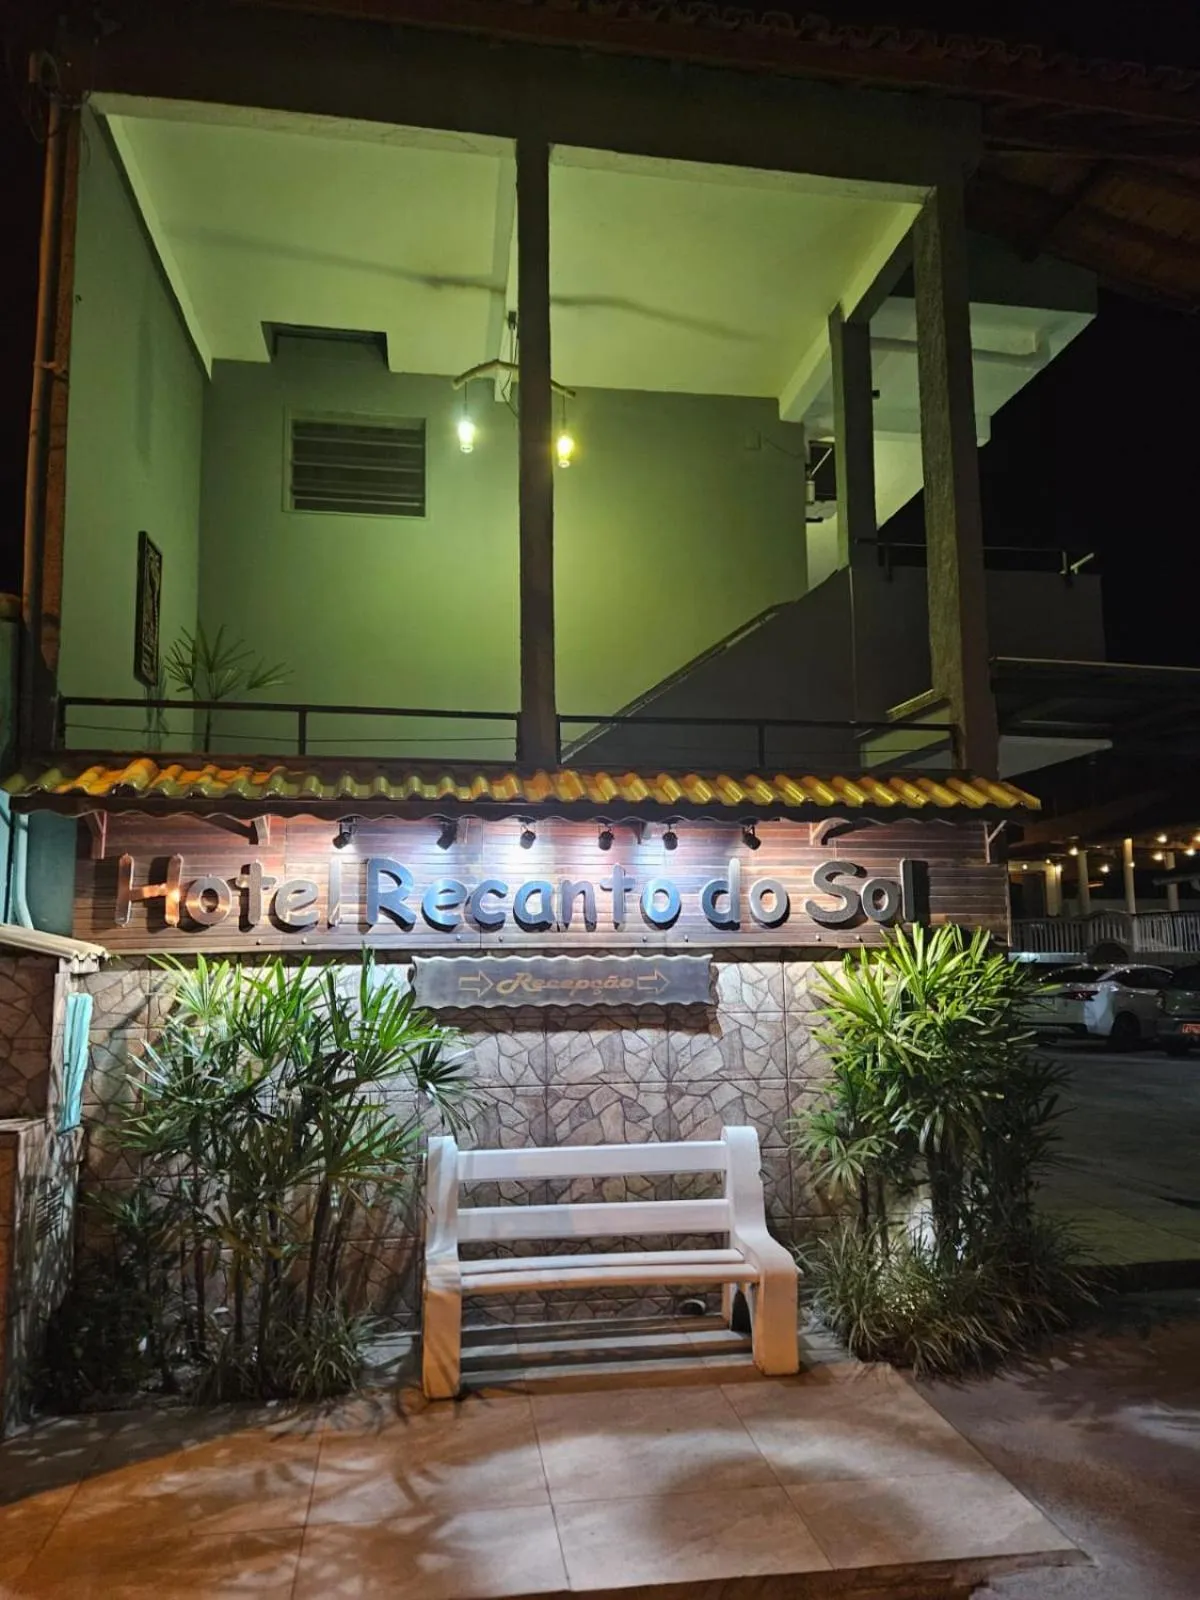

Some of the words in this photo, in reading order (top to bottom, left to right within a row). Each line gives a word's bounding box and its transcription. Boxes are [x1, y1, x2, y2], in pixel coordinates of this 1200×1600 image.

[114, 853, 341, 928] Hotel
[366, 857, 682, 931] Recanto
[700, 857, 788, 930] do
[805, 858, 919, 926] Sol
[496, 972, 635, 995] Recepção
